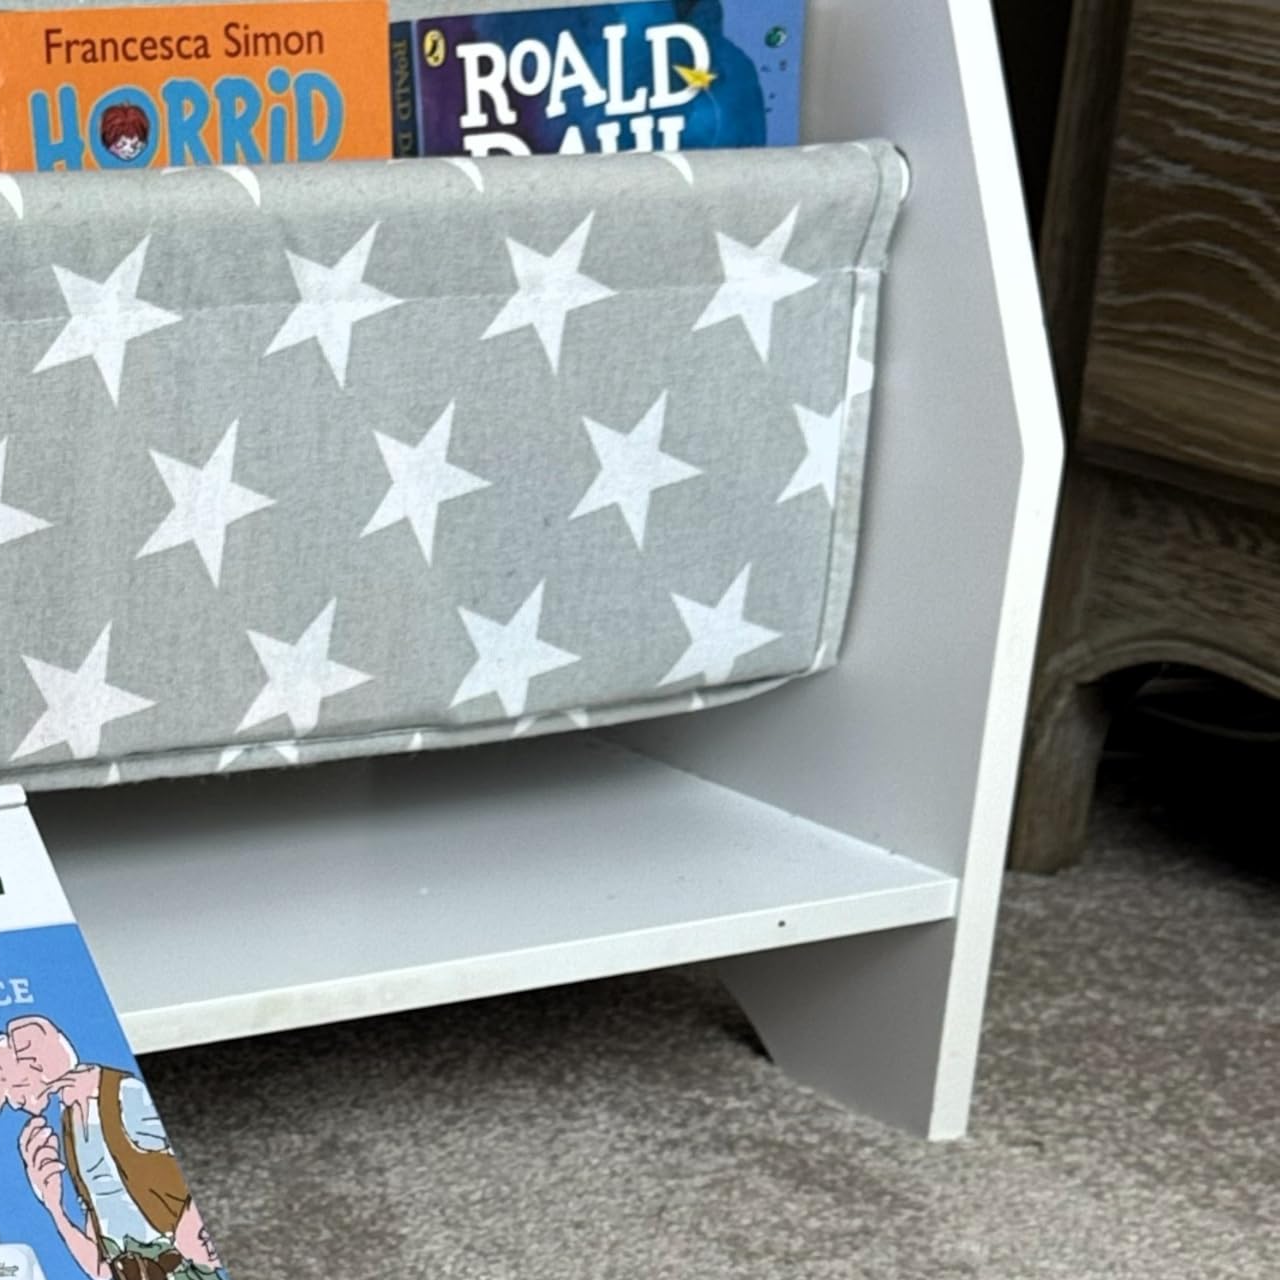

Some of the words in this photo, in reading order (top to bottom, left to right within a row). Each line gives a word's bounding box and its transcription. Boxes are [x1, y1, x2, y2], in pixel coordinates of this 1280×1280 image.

[44, 27, 211, 65] Francesca
[223, 21, 325, 58] Simon
[456, 23, 711, 129] ROALD
